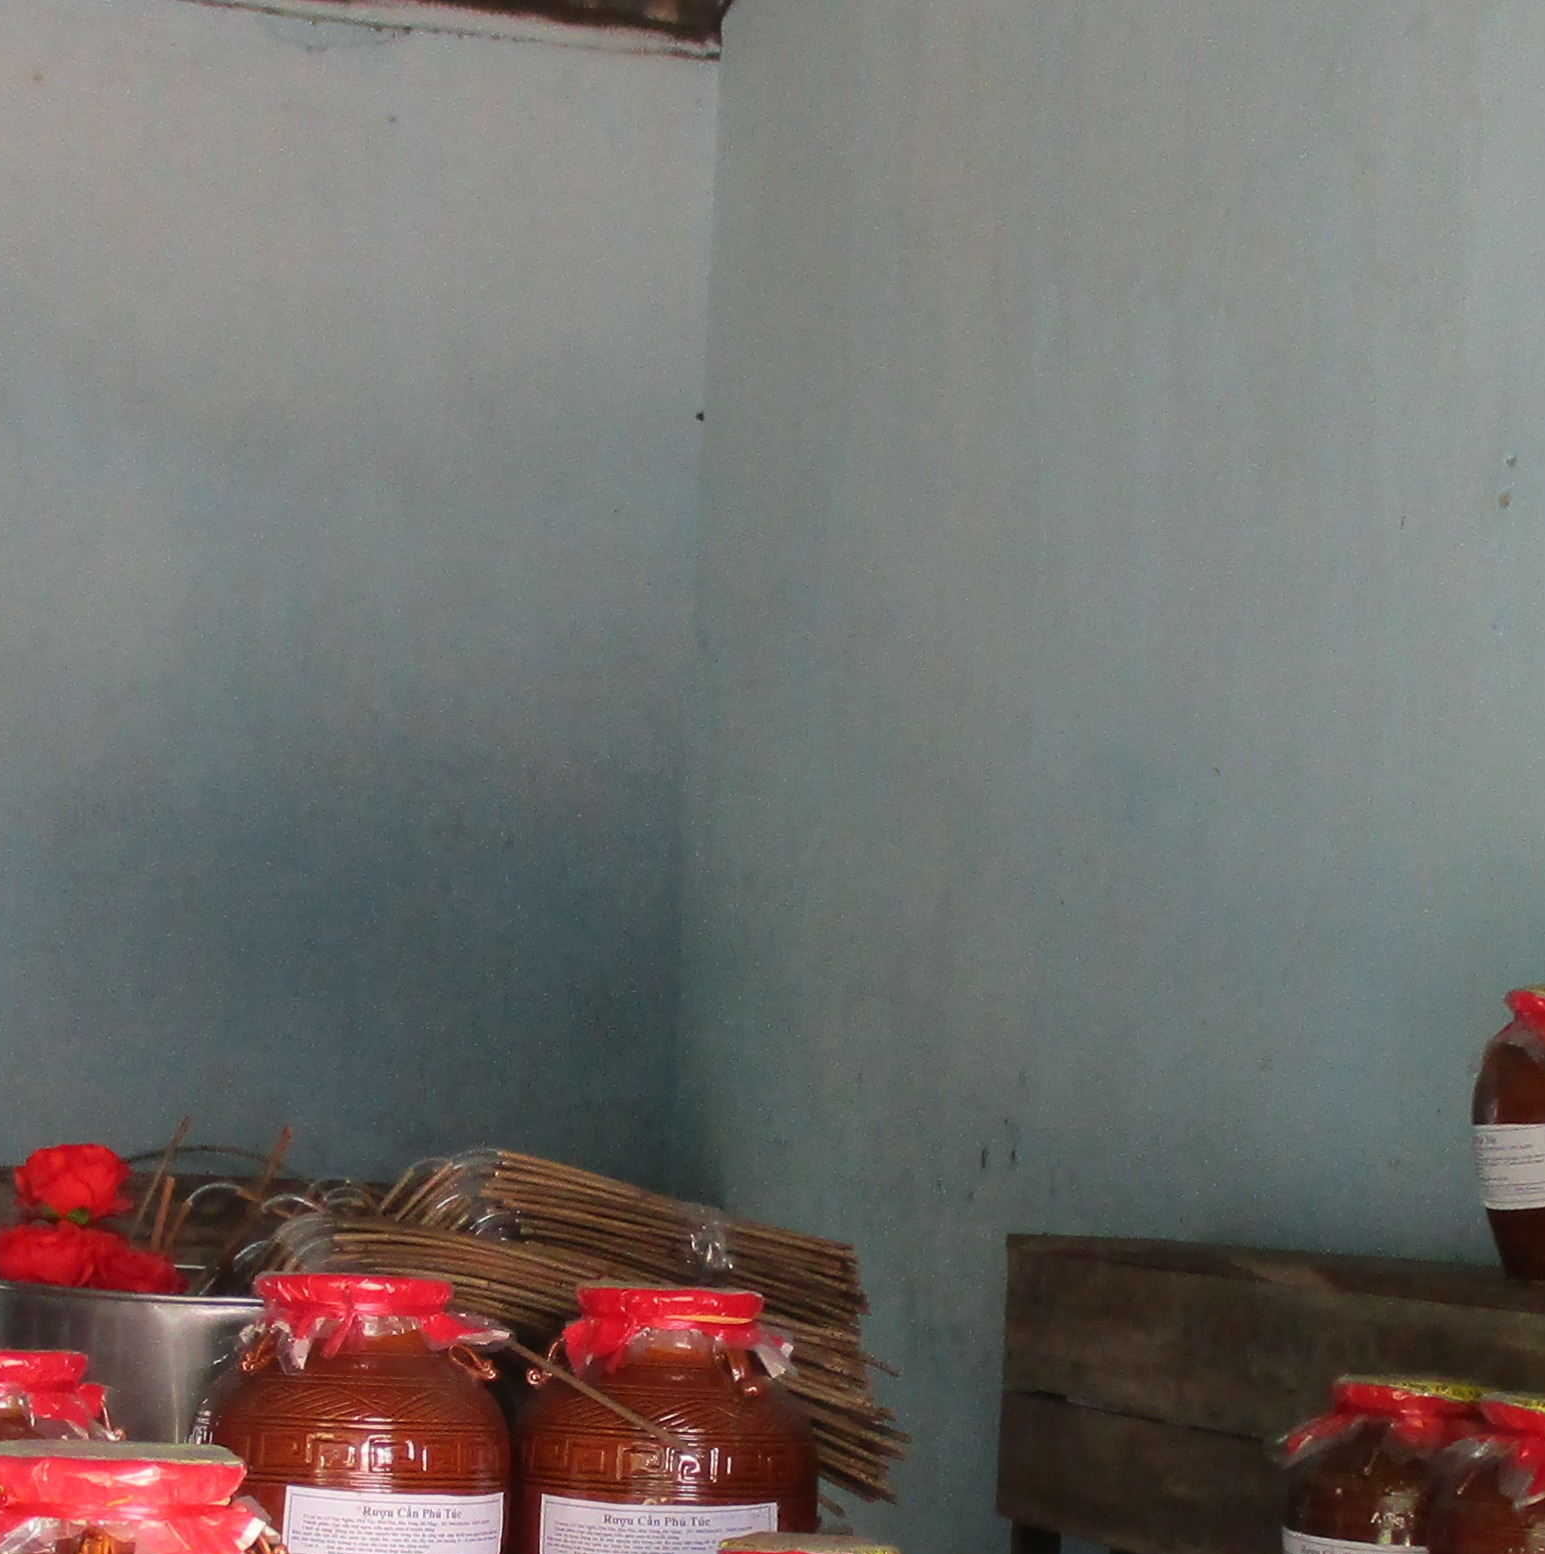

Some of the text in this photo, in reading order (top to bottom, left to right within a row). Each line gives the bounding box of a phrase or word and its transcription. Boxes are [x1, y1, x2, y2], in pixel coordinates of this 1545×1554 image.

[362, 1505, 462, 1519] Rượu Cần Phú Túc
[604, 1514, 711, 1527] Rượu Cần Phú Túc
